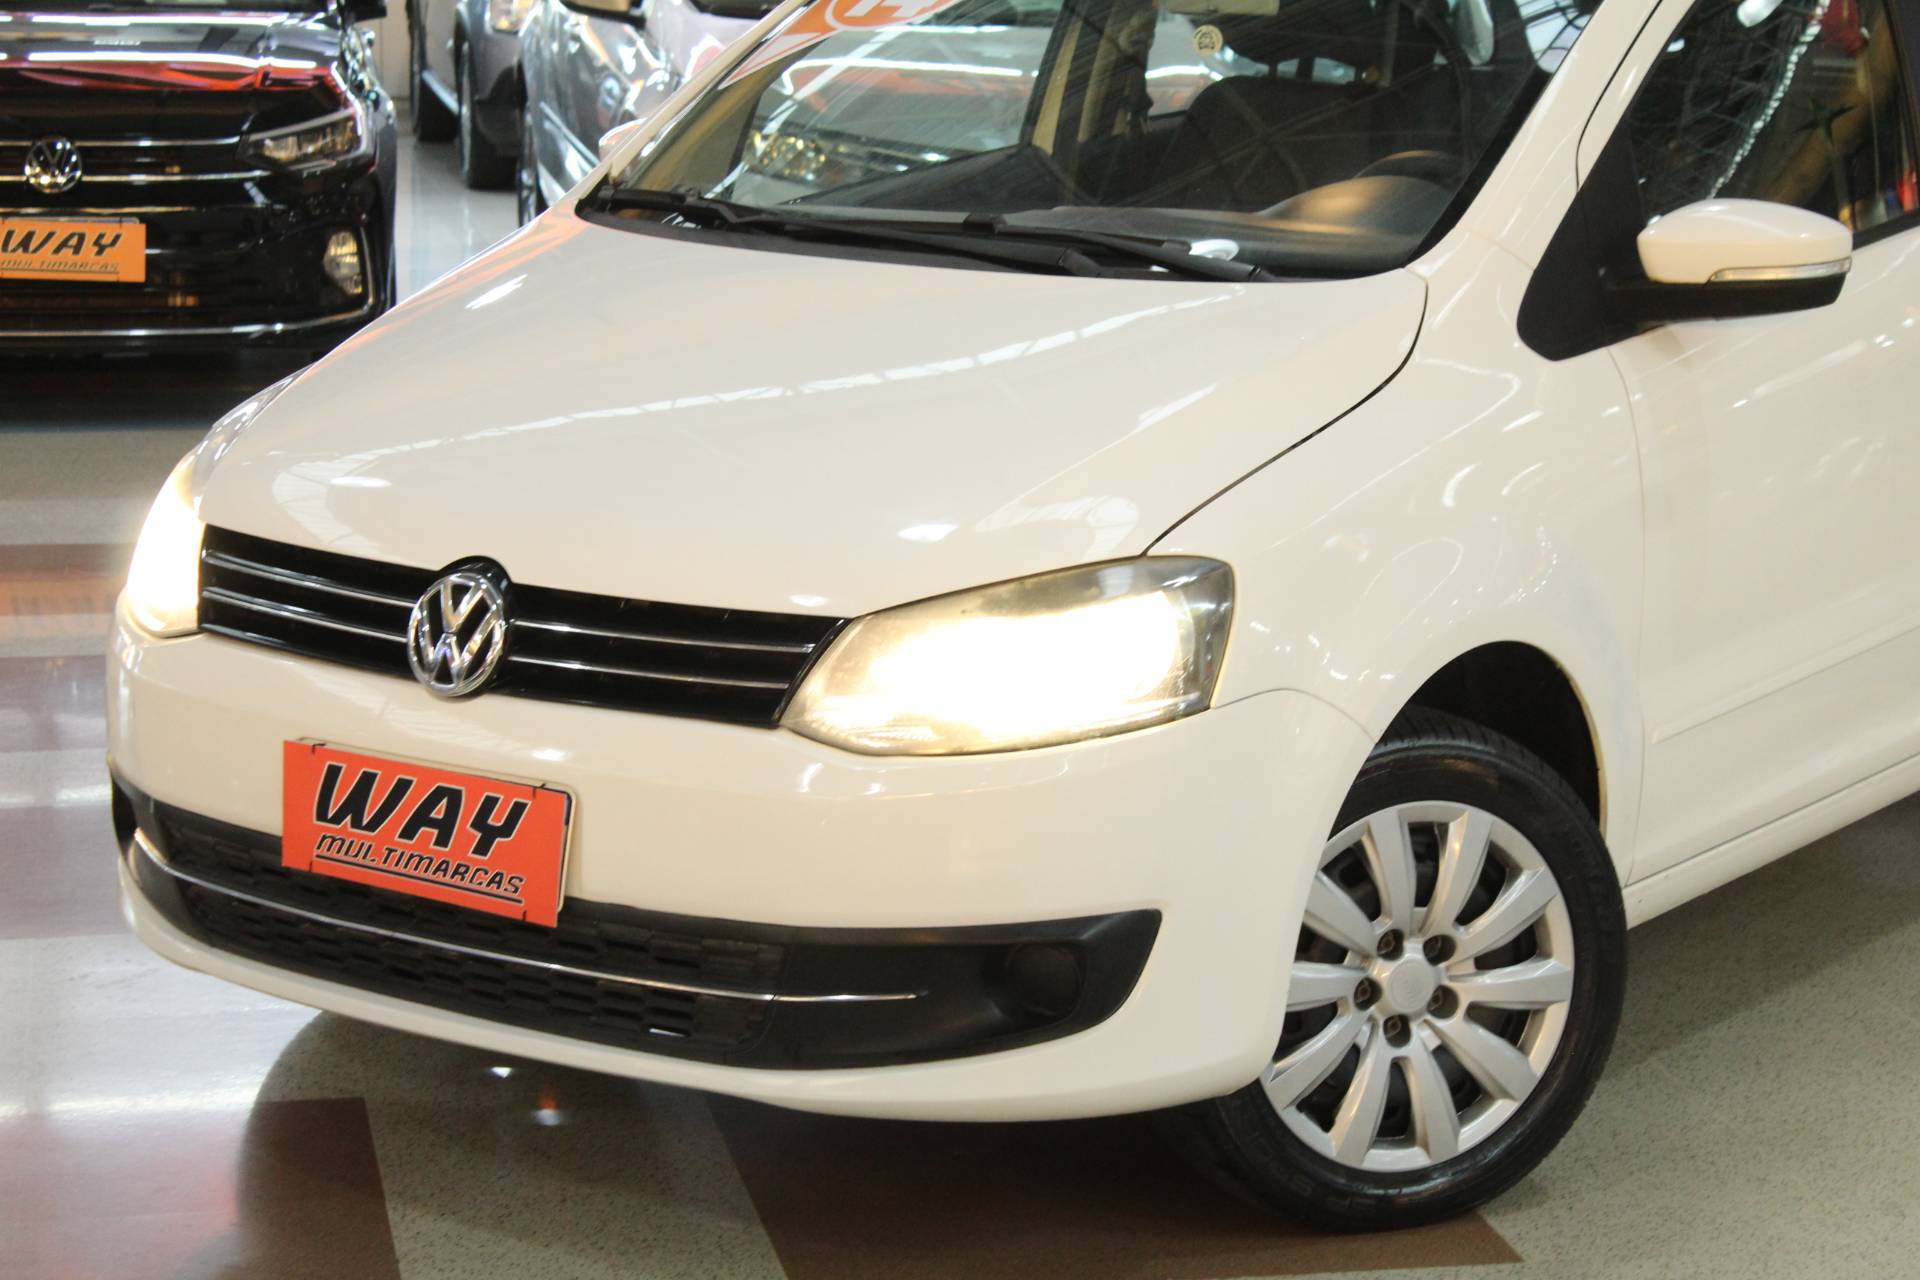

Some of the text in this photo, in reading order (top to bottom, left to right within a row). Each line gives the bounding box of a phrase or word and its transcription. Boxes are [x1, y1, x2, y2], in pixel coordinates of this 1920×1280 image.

[1, 229, 122, 256] WAY
[407, 572, 506, 697] VW
[314, 762, 530, 859] WAY
[316, 833, 525, 894] MULTIMARCAS
